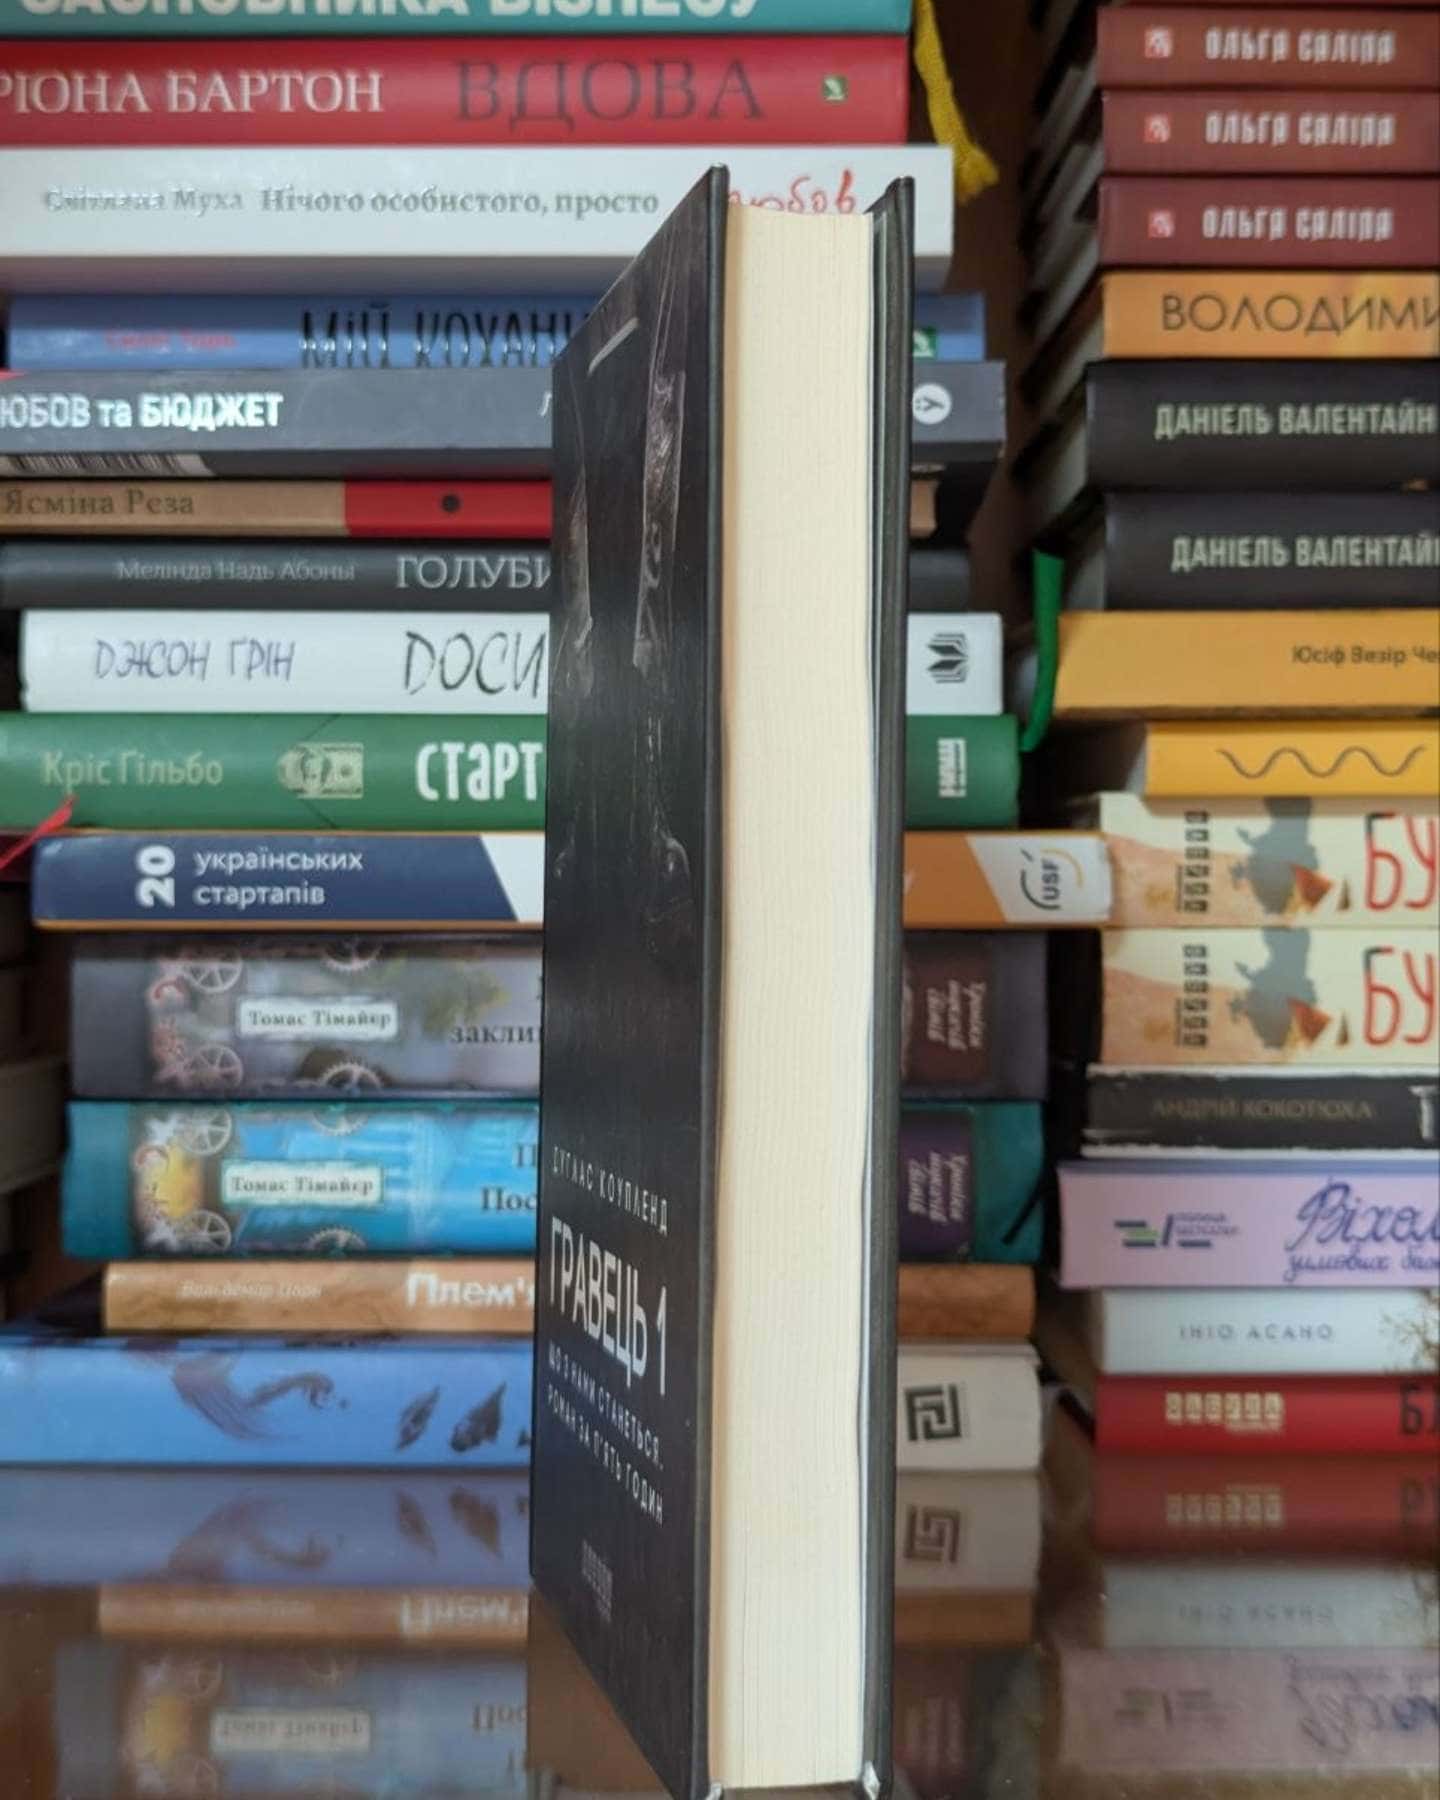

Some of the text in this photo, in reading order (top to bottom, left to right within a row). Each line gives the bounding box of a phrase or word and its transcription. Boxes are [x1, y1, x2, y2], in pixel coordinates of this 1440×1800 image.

[166, 70, 383, 112] БАРТОН
[455, 57, 763, 132] ВДОВА
[261, 186, 364, 213] Нічого
[370, 185, 548, 217] особистого,
[555, 190, 659, 219] просто
[97, 400, 132, 427] та
[140, 392, 284, 431] БЮДЖЕТ
[136, 844, 176, 908] 20
[194, 846, 364, 876] українських
[193, 880, 326, 910] стартапів
[450, 1023, 548, 1045] закли
[551, 1215, 667, 1396] ГРАВЕЦЬ 1
